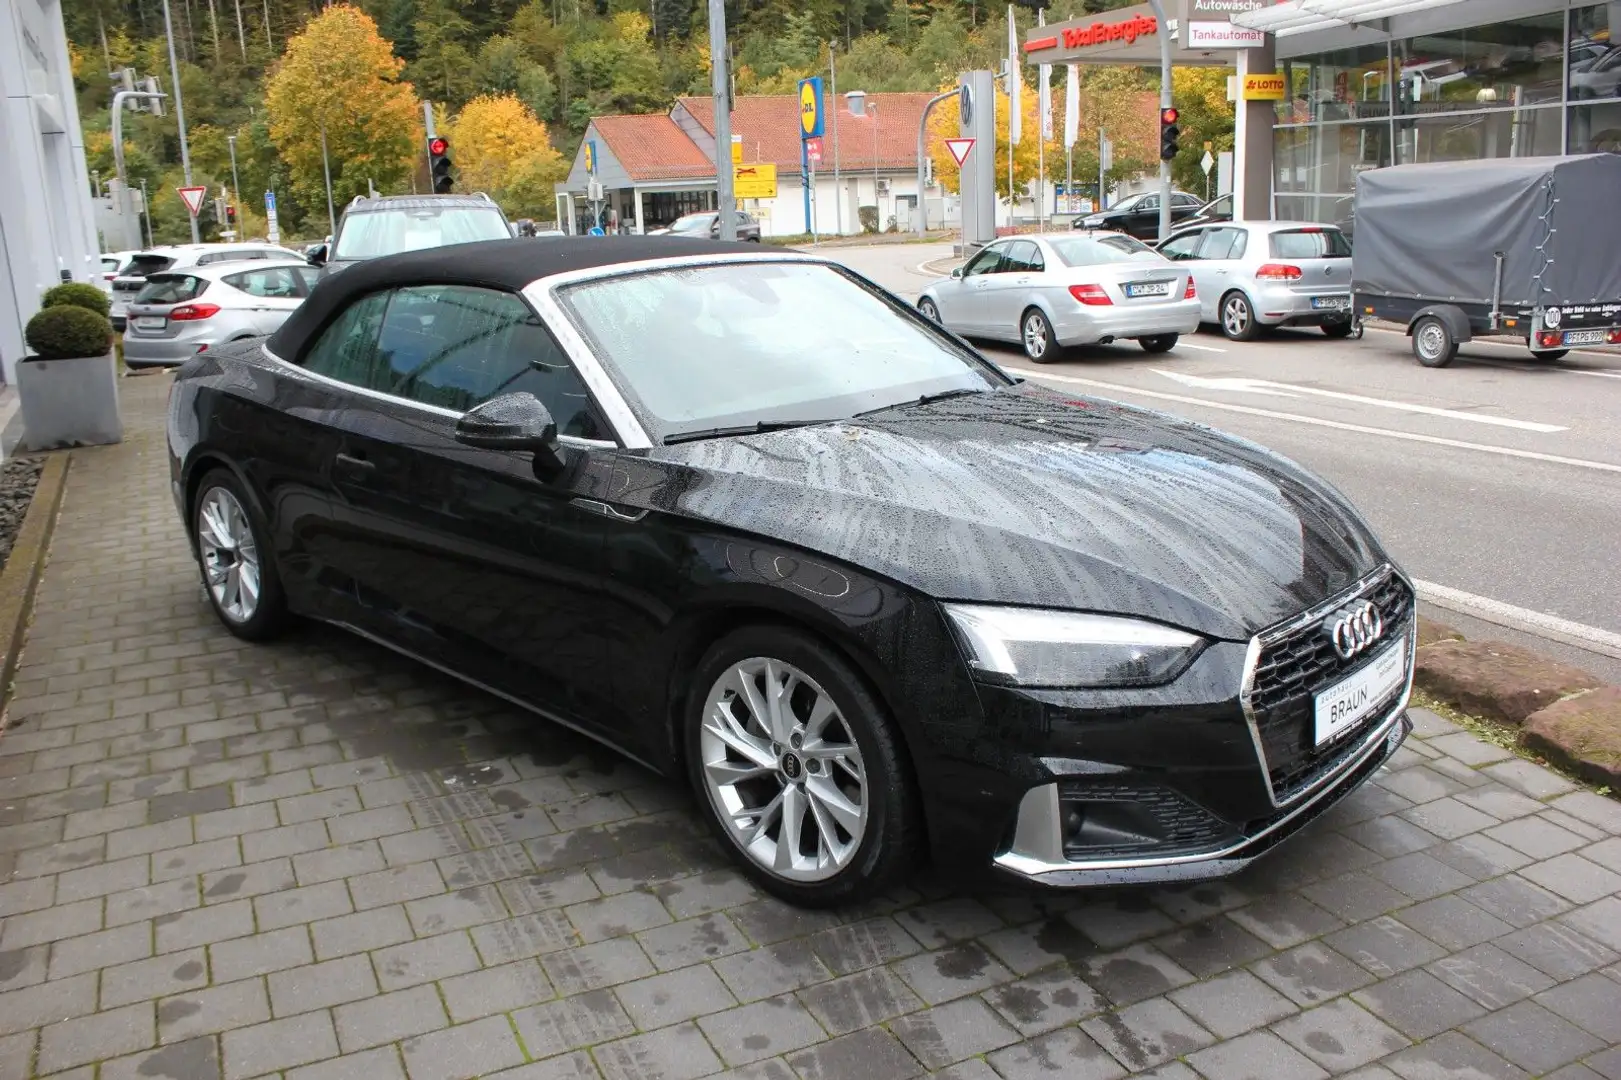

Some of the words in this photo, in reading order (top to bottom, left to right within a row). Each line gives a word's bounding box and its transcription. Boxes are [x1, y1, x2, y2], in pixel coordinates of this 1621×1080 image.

[1062, 14, 1158, 48] TotalEnergies
[1192, 30, 1262, 41] Tankautomat
[1257, 79, 1285, 89] LOTTO
[1547, 310, 1559, 324] 100
[1330, 682, 1368, 724] BRAUN
